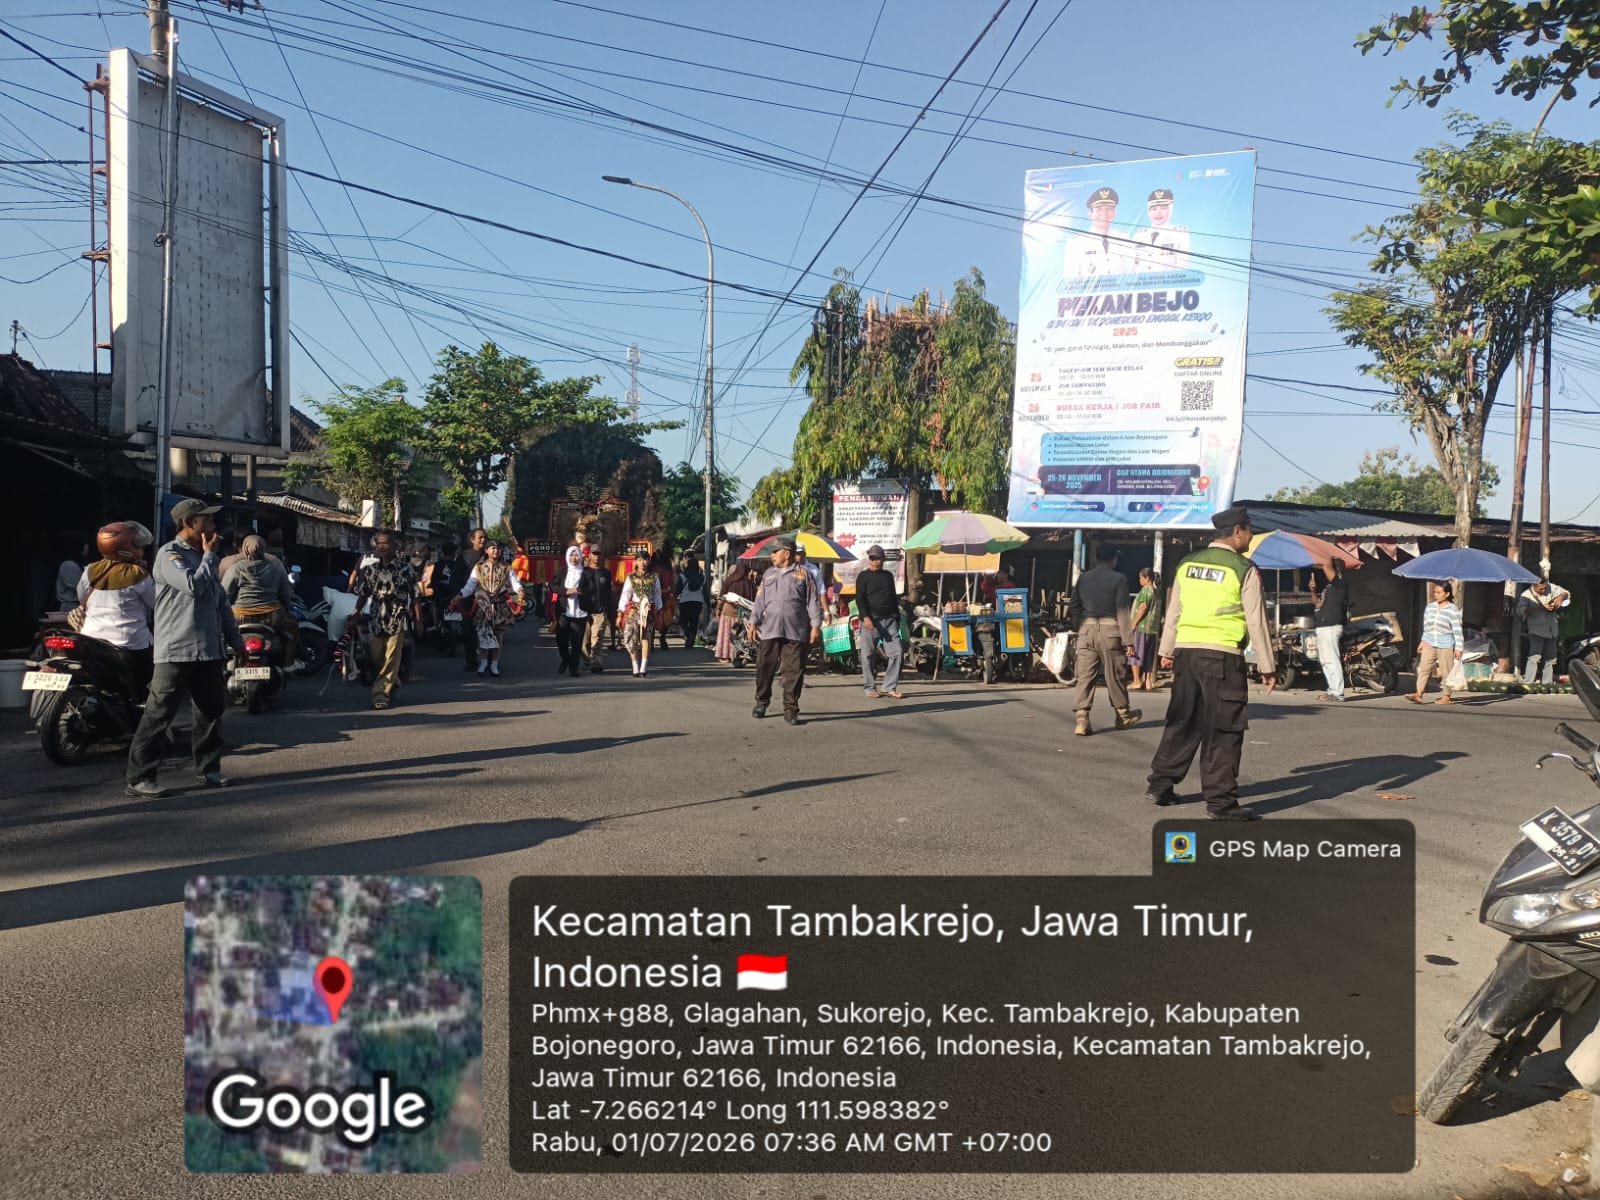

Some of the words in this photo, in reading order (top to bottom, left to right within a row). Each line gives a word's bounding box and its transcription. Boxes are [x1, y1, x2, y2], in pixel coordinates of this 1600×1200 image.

[1136, 290, 1200, 313] BEJO
[1113, 327, 1138, 337] 2025
[1141, 340, 1155, 348] dan
[1028, 403, 1040, 413] 26
[1056, 404, 1084, 412] BURSA
[1086, 403, 1113, 411] KERJA
[1121, 402, 1138, 410] JOB
[1068, 473, 1102, 481] NOVEMBER
[1152, 468, 1191, 476] BOJONEGORO
[1540, 812, 1558, 825] K
[1551, 821, 1582, 846] 3579
